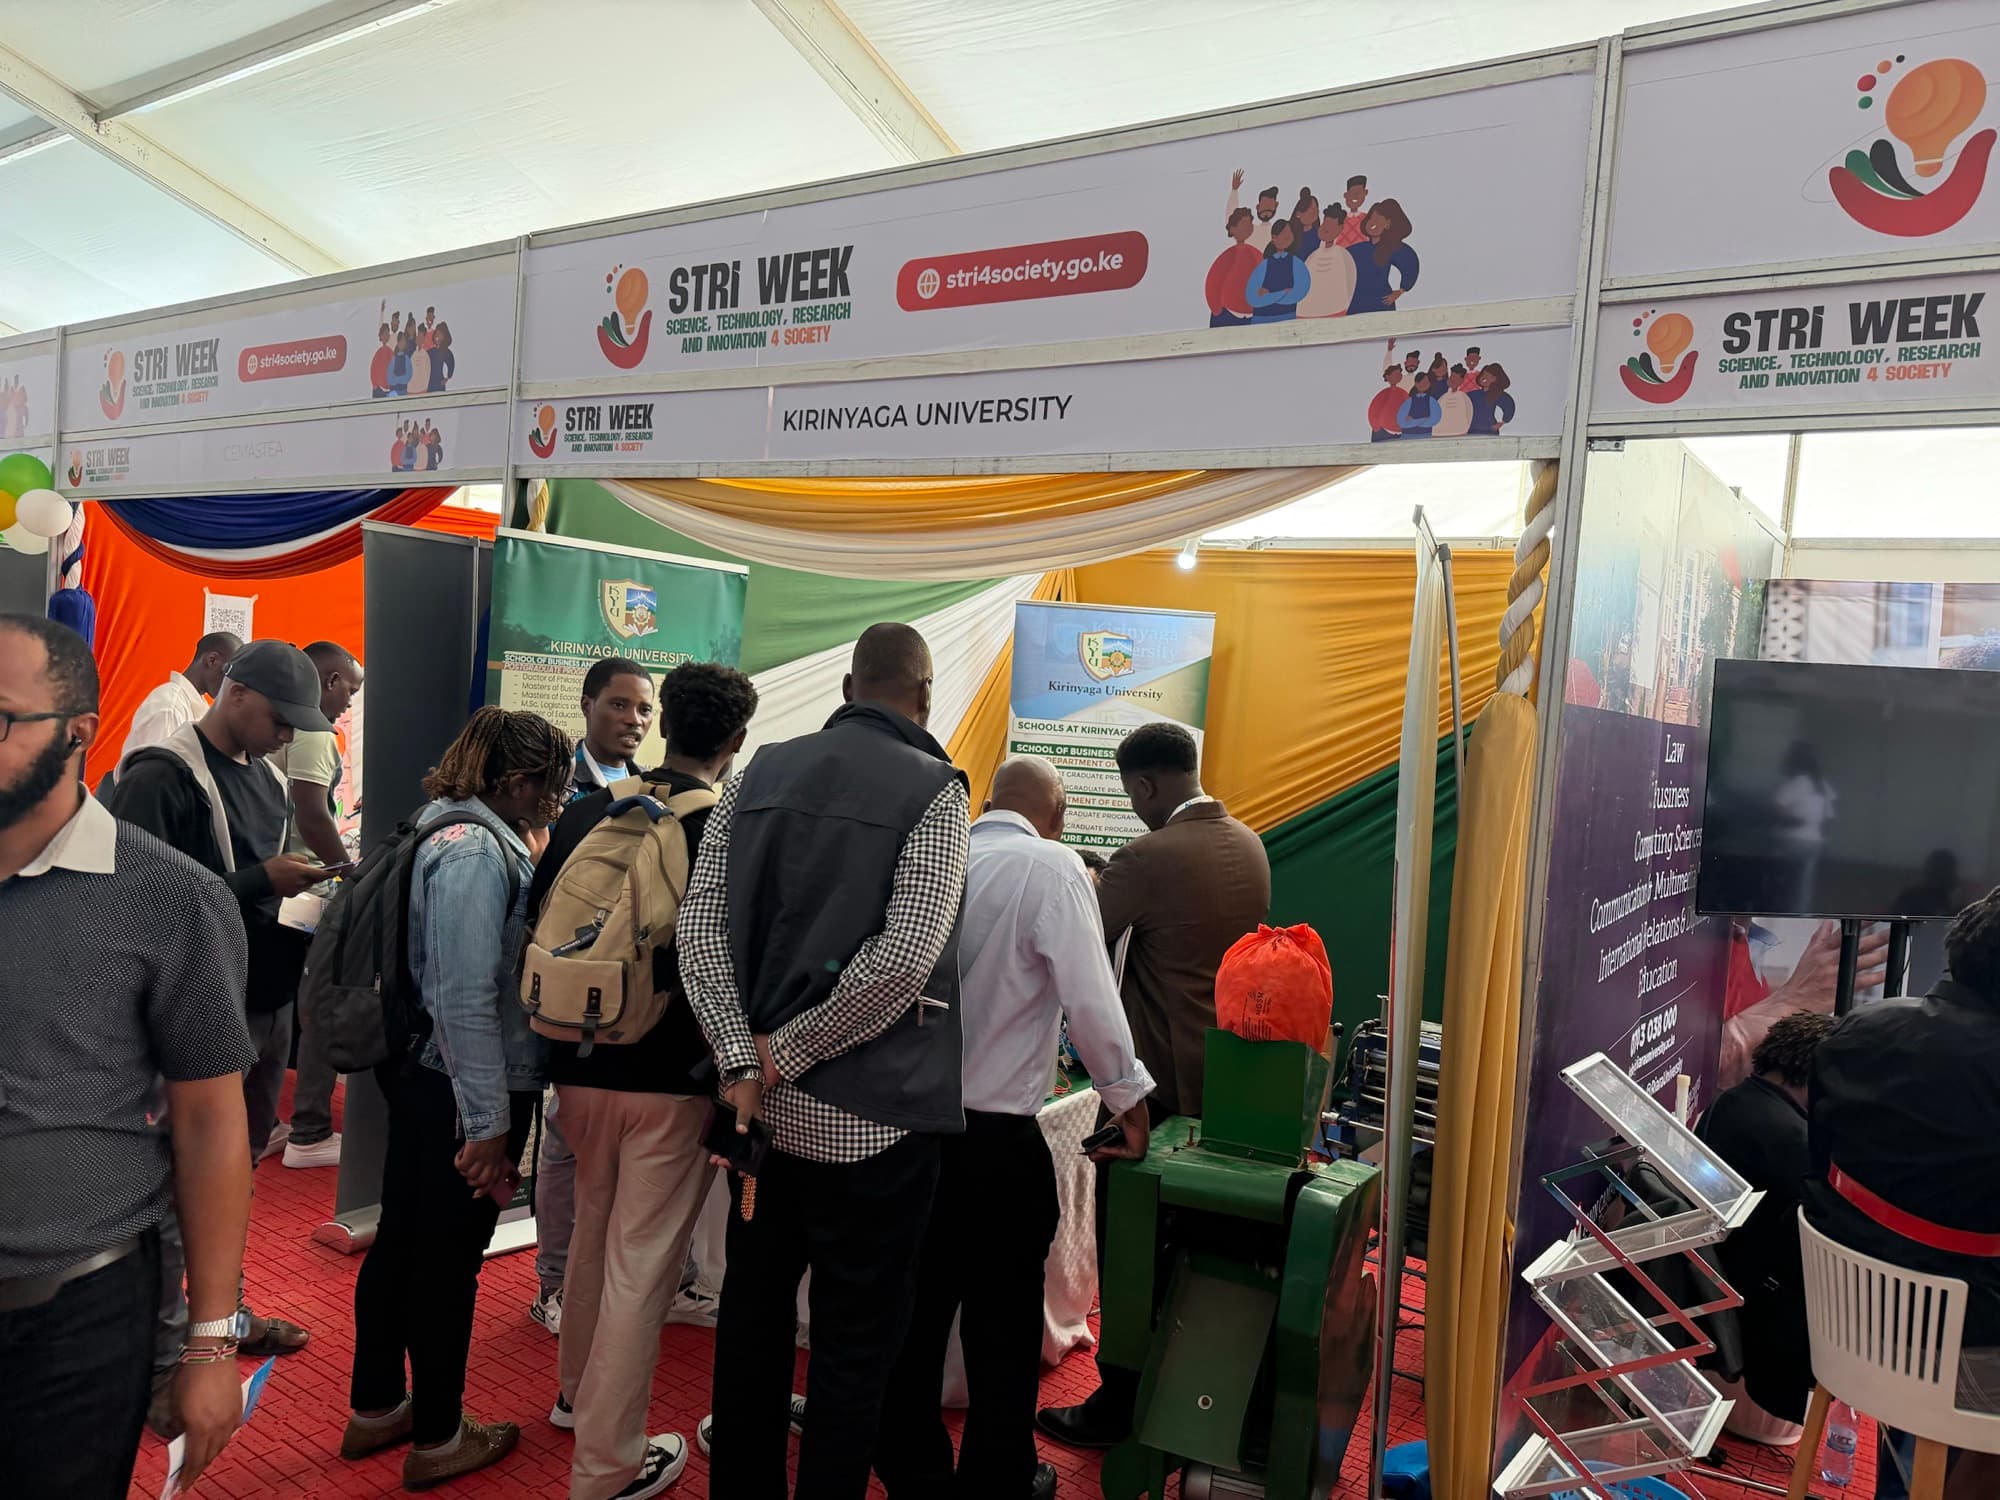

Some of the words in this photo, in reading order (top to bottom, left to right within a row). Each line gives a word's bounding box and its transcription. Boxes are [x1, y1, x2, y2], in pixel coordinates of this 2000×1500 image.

[757, 245, 854, 306] WEEK
[946, 250, 1123, 289] stri4society.go.ke
[666, 317, 711, 335] SCIENCE,
[716, 309, 787, 331] TECHNOLOGY,
[792, 302, 852, 324] RESEARCH
[1848, 292, 1986, 346] WEEK
[681, 337, 703, 353] AND
[770, 330, 780, 347] 4
[784, 325, 831, 346] SOCIETY
[176, 338, 220, 377] WEEK
[259, 347, 337, 369] stri4society.go.ke
[1718, 355, 1782, 373] SCIENCE,
[1790, 349, 1890, 369] TECHNOLOGY,
[1897, 342, 1981, 362] RESEARCH
[1739, 374, 1769, 389] AND
[1866, 366, 1878, 382] 4
[1885, 362, 1952, 380] SOCIETY
[609, 403, 654, 430] WEEK
[783, 404, 908, 431] KIRINYAGA
[916, 395, 1073, 426] UNIVERSITY
[625, 431, 653, 440] RESEARCH
[107, 446, 130, 467] WEEK
[504, 654, 535, 664] SCHOOL
[536, 657, 547, 665] OF
[547, 658, 580, 668] BUSINESS
[550, 641, 620, 658] KIRINYAGA
[624, 647, 694, 664] UNIVERSITY
[521, 682, 550, 690] Masters
[521, 691, 550, 699] Masters
[1048, 680, 1101, 696] Kirinyaga
[1105, 685, 1163, 701] University
[540, 700, 569, 711] Logistics
[1018, 721, 1064, 732] SCHOOLS
[1066, 725, 1079, 733] AT
[1016, 744, 1054, 754] SCHOOL
[1056, 747, 1069, 755] OF
[1070, 748, 1114, 758] BUSINESS
[1665, 734, 1685, 763] Law
[1067, 771, 1103, 780] GRADUATE
[1084, 836, 1104, 845] AND
[1680, 906, 1686, 934] &
[1647, 1013, 1663, 1042] 038
[1663, 1003, 1678, 1033] 000
